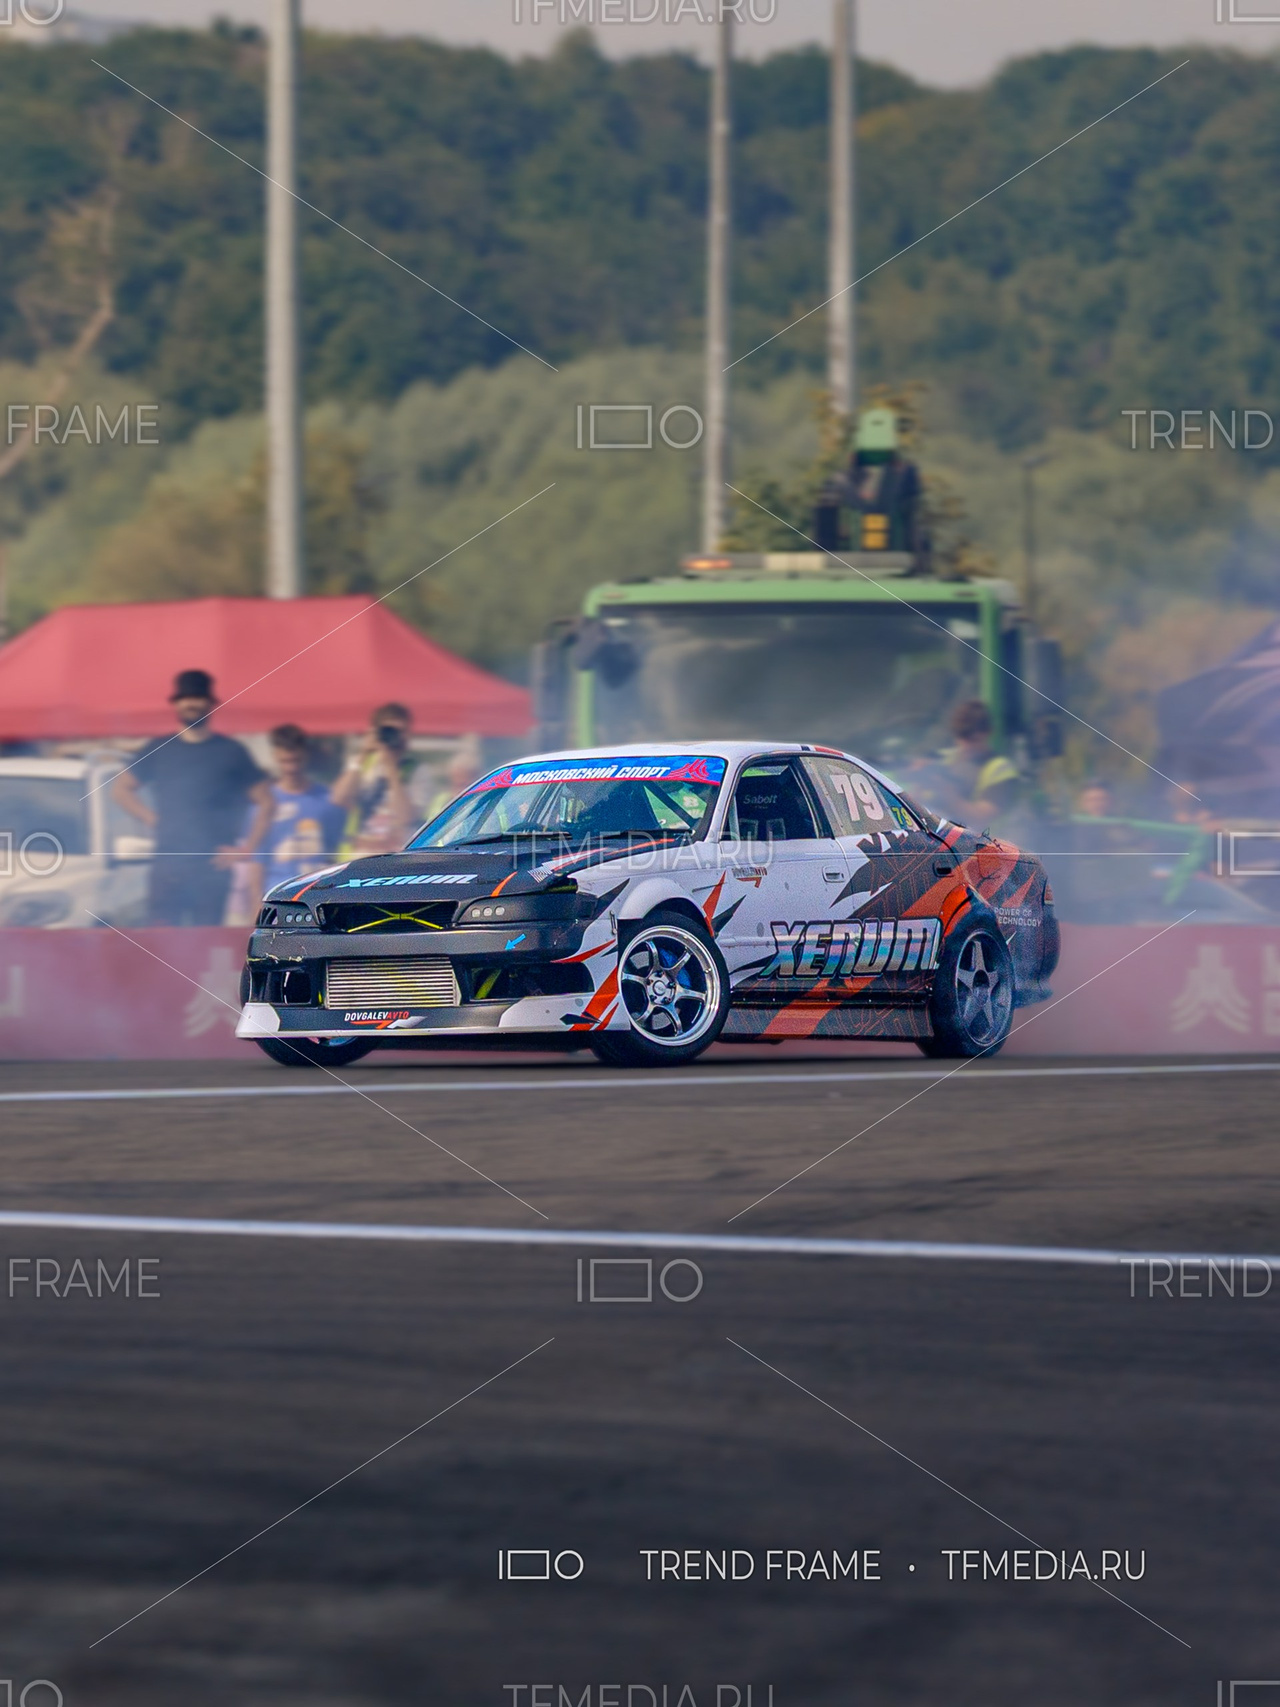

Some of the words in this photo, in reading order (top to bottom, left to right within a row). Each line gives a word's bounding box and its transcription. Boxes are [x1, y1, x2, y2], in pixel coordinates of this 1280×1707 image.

[512, 764, 619, 785] МОСКОВСКИЙ
[614, 766, 672, 779] СПОРТ
[830, 772, 884, 822] 79
[891, 806, 913, 827] 79
[335, 873, 478, 889] XENUM
[994, 907, 1021, 917] POWER
[997, 917, 1042, 928] ECHNOLOGY
[758, 917, 942, 980] XENUM
